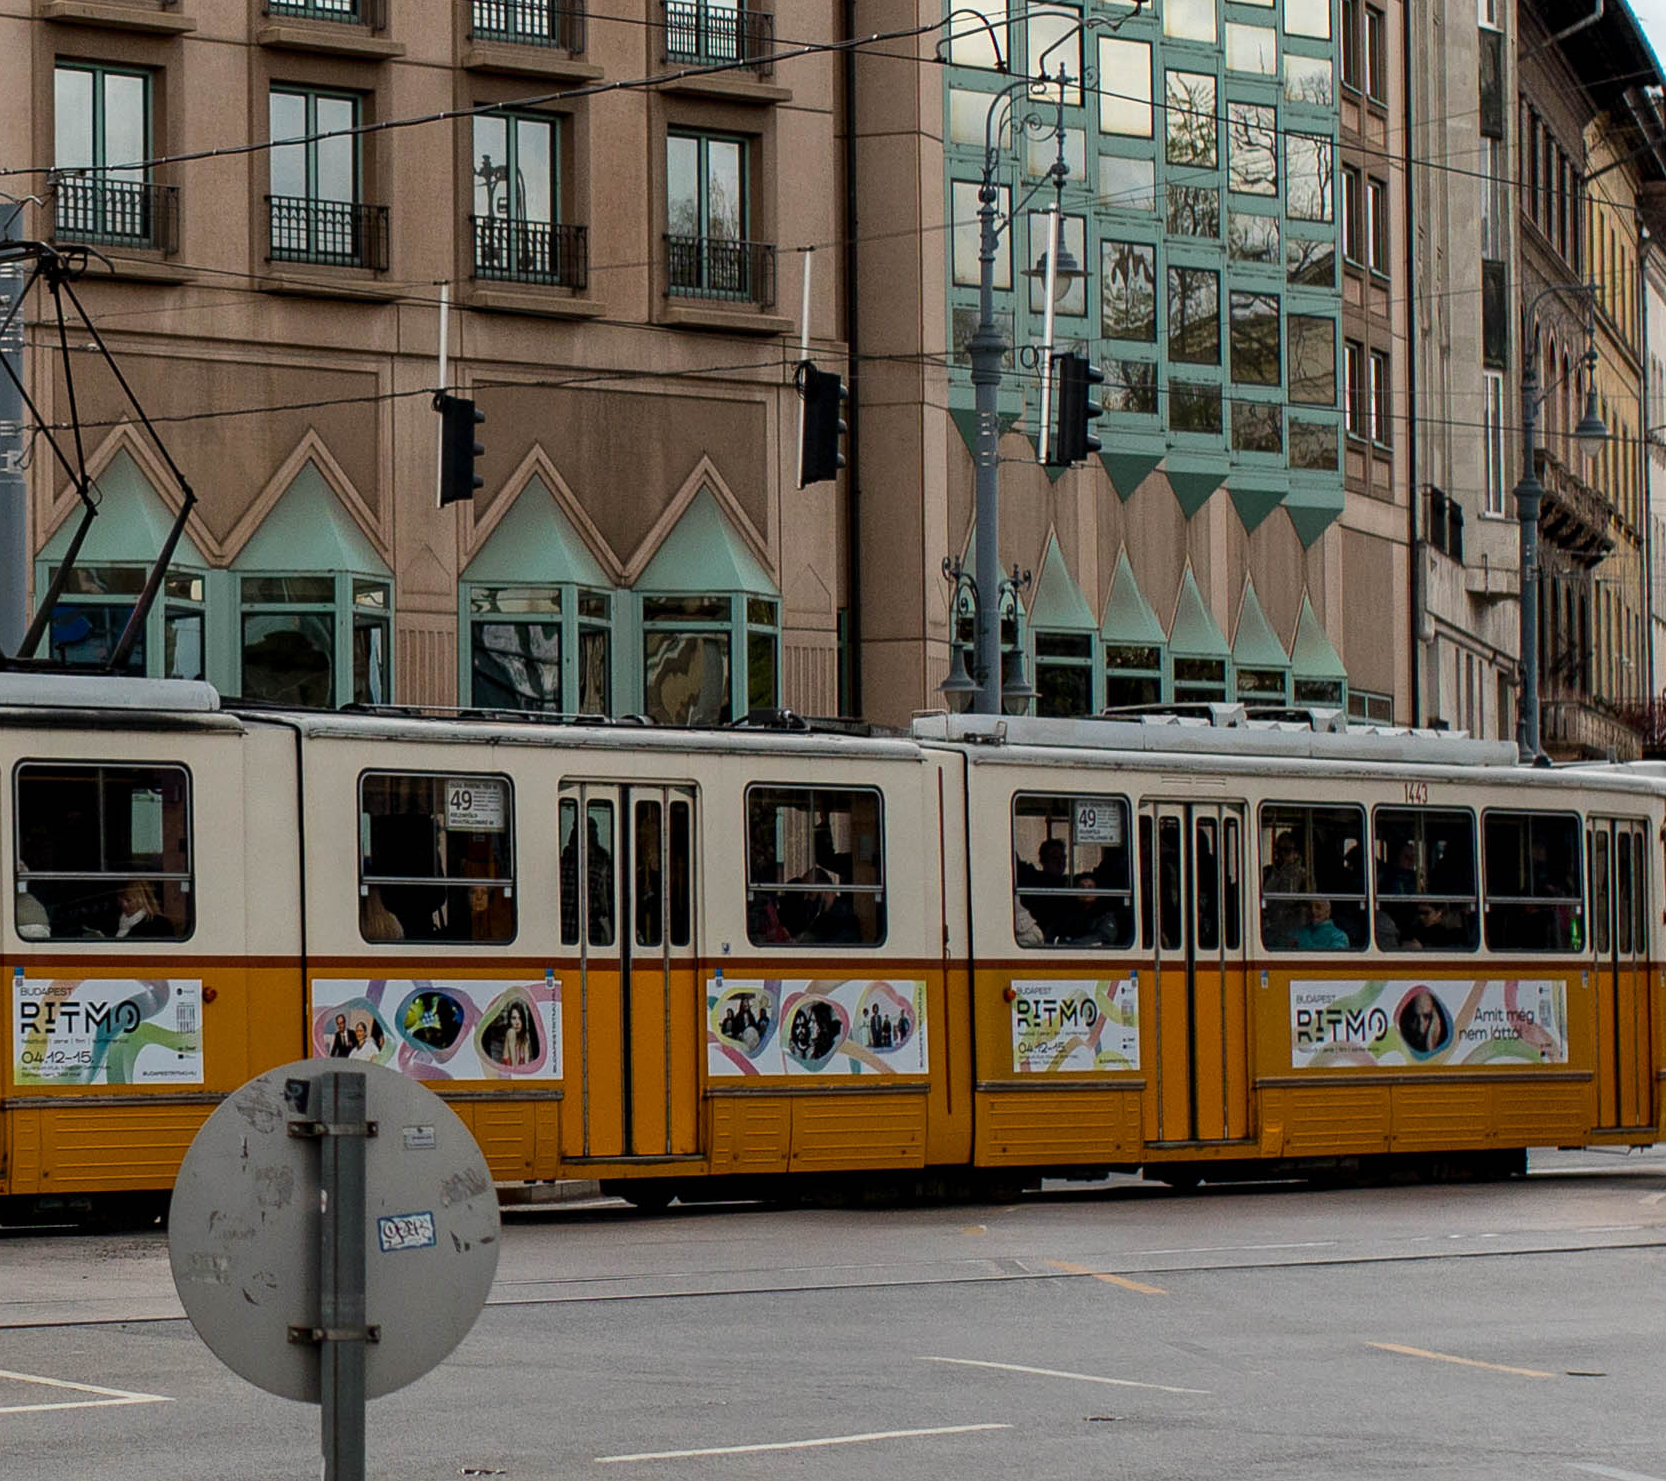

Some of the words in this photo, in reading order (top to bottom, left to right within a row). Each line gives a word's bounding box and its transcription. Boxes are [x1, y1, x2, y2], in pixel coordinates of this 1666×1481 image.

[450, 789, 473, 811] 49
[1079, 809, 1096, 828] 49
[20, 987, 73, 997] BUDAPEST
[1296, 994, 1336, 1004] BUDAPEST
[20, 1000, 141, 1034] RITMO
[1017, 998, 1098, 1027] RITMO
[1474, 1007, 1504, 1022] Amit
[1506, 1007, 1534, 1025] még
[1297, 1007, 1388, 1042] RITMO
[1459, 1028, 1488, 1040] nem
